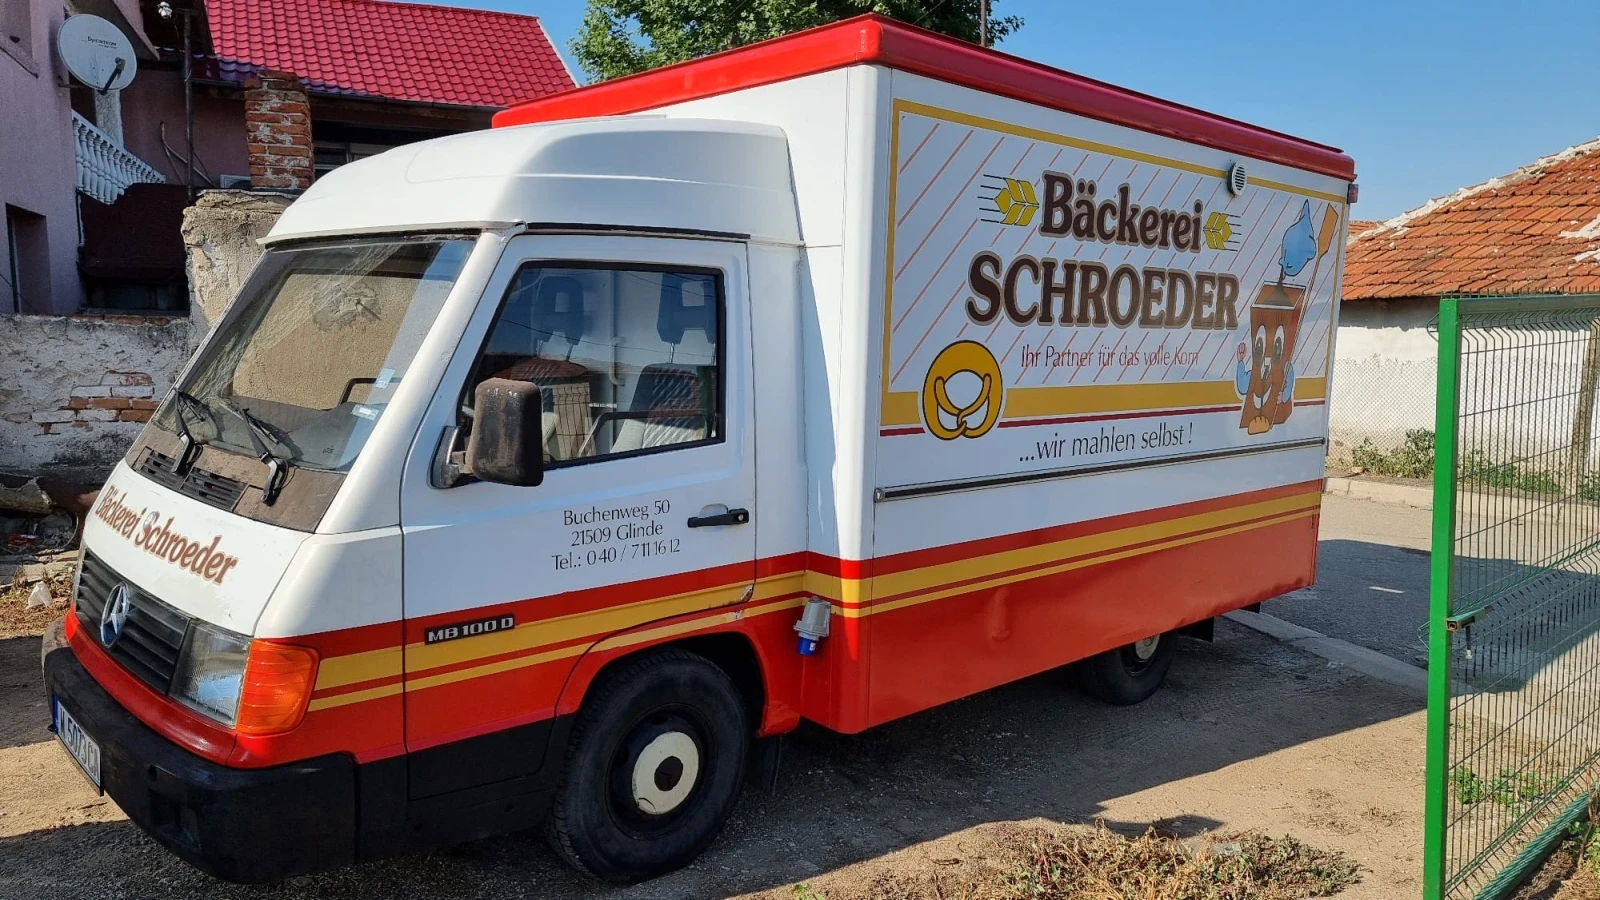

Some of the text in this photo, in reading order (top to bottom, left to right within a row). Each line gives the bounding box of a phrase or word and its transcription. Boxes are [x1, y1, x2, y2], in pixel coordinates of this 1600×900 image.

[1039, 170, 1203, 253] Bäckerei
[965, 250, 1239, 330] SCHROEDER
[1021, 344, 1199, 368] Ihr Partner für das volle Korn
[1072, 426, 1136, 456] mahlen
[1141, 422, 1184, 449] selbst
[563, 499, 671, 526] Buchenweg 50
[95, 485, 239, 586] Bäckerei Schroeder
[571, 520, 664, 547] 21509 Glinde
[551, 551, 582, 571] Tel.:
[586, 547, 617, 566] 040
[427, 617, 514, 642] MB 100 D
